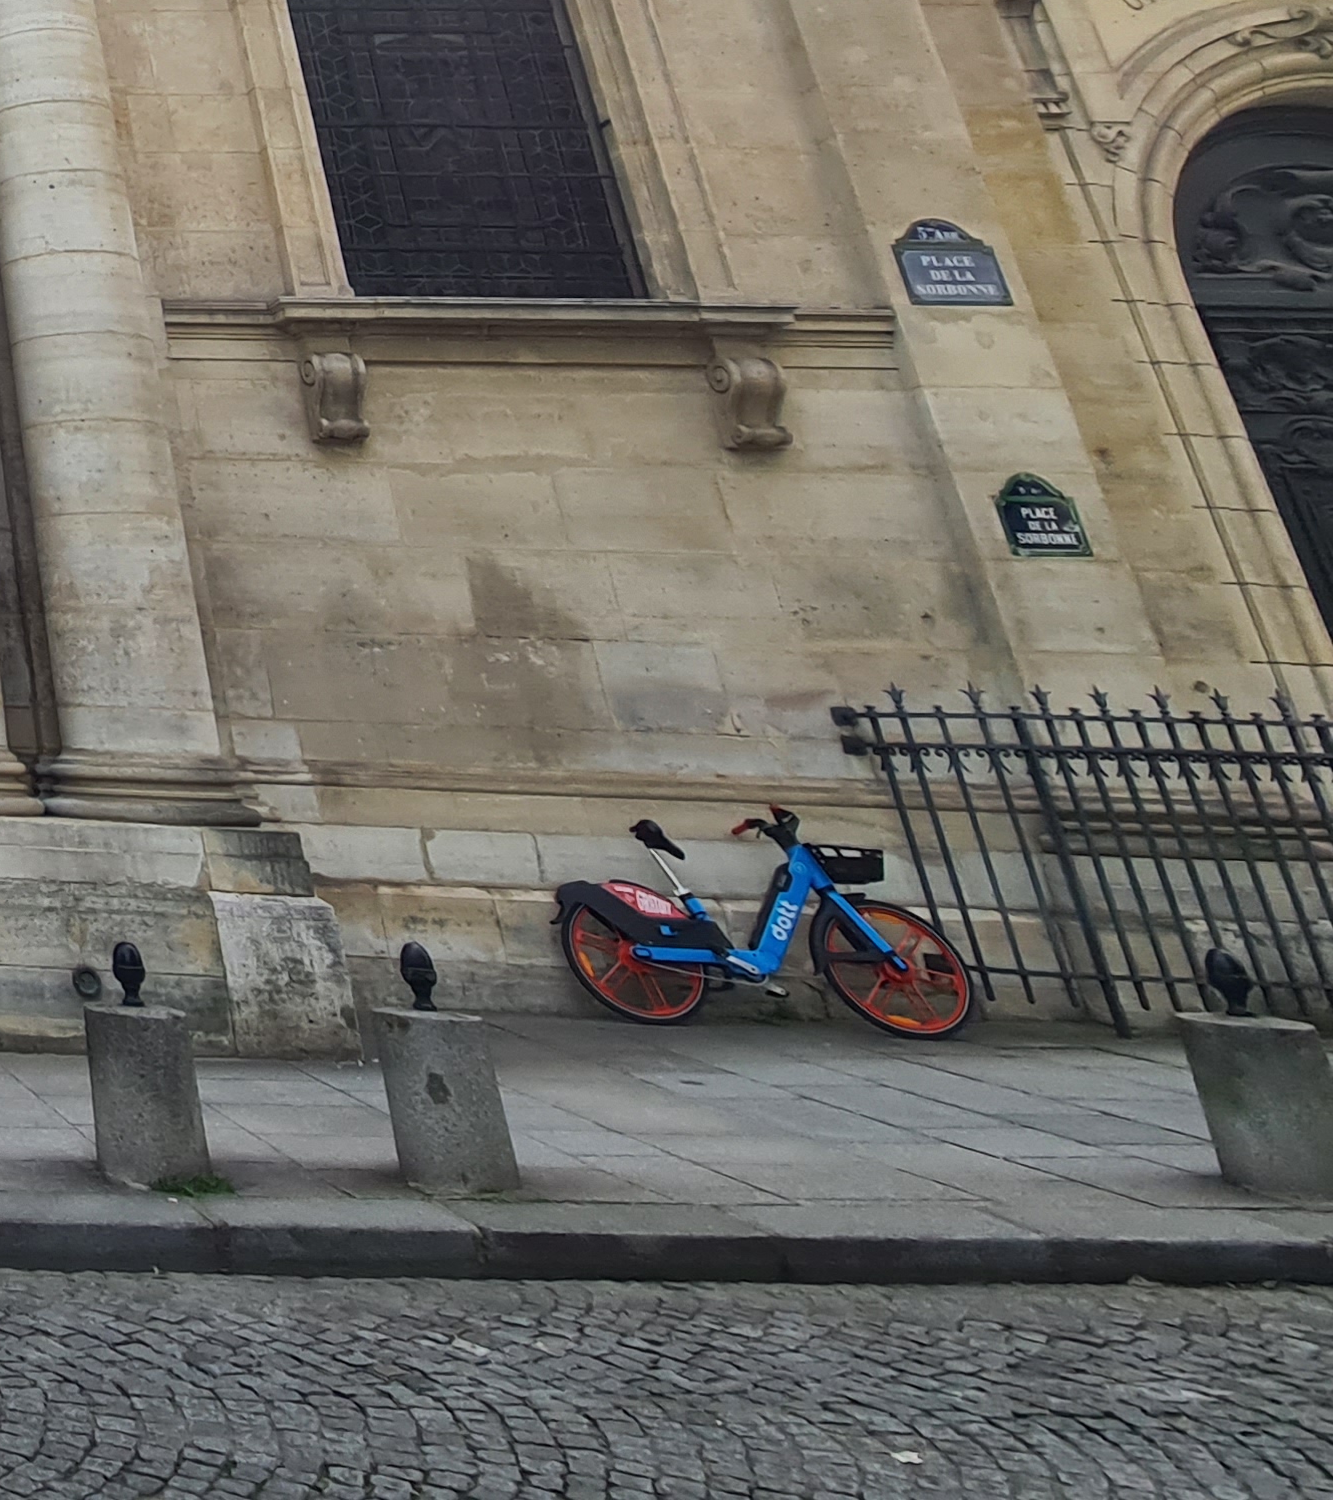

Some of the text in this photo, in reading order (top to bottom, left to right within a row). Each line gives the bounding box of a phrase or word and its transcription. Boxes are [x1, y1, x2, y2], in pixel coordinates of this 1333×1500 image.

[920, 255, 975, 268] PLACE
[929, 269, 976, 282] DE LA
[916, 283, 1000, 296] SORBONNE
[1020, 507, 1058, 519] PLACE
[1027, 521, 1059, 531] DE LA
[1016, 532, 1080, 545] SORBONNE
[770, 900, 799, 941] dott
